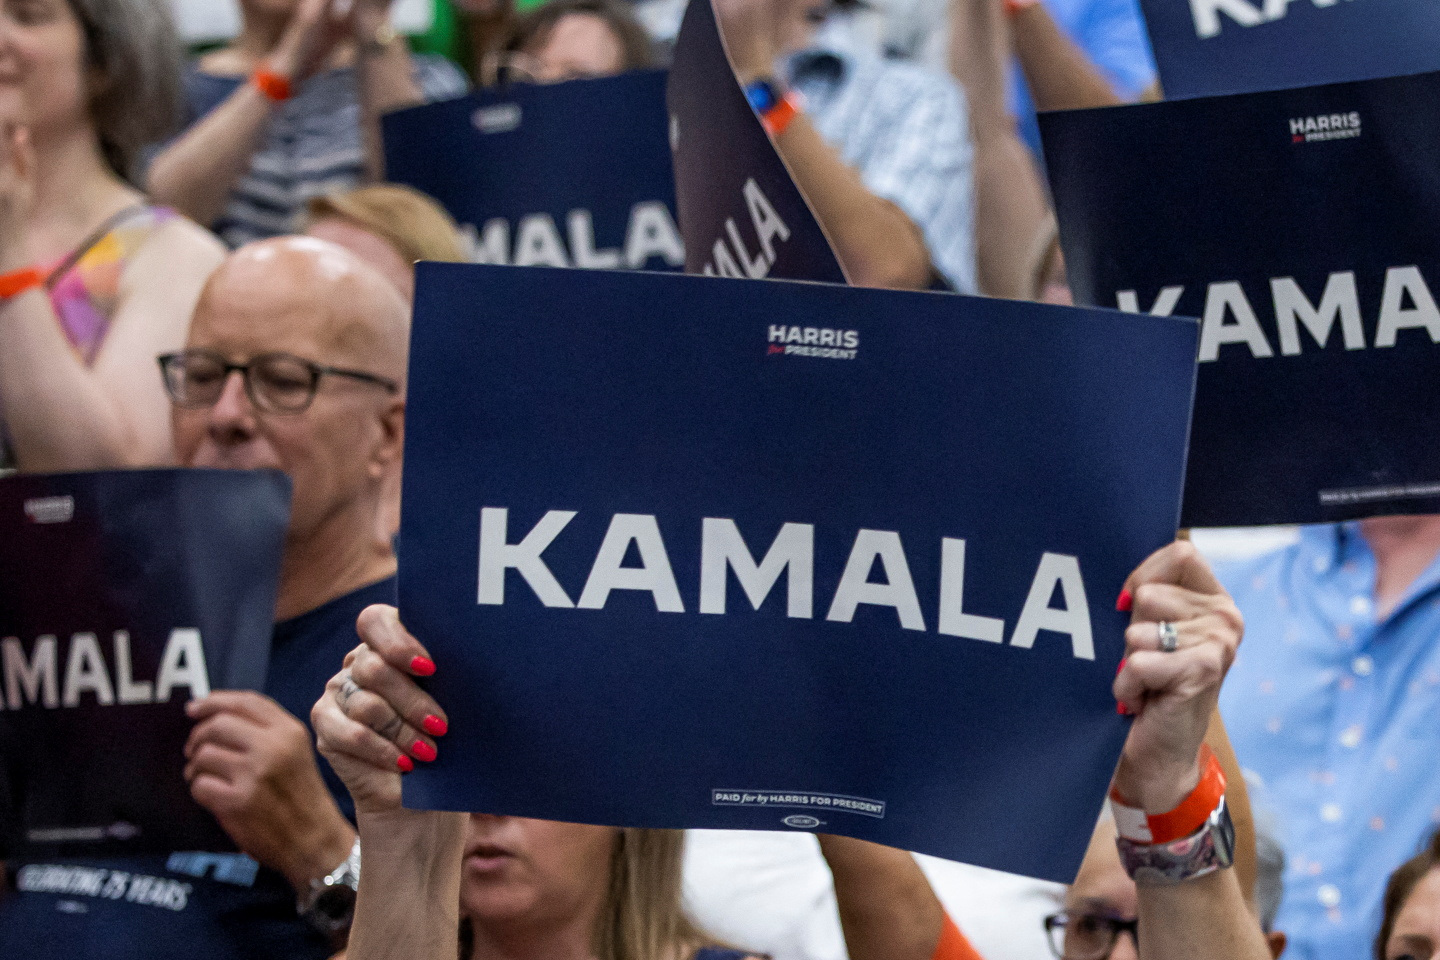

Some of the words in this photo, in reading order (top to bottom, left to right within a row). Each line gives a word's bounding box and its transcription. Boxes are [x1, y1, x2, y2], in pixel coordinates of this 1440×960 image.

[1289, 111, 1361, 134] HARRIS
[458, 201, 687, 270] MALA
[704, 178, 791, 279] ALA
[767, 324, 859, 348] HARRIS
[785, 345, 858, 360] PRESIDENT
[477, 506, 1096, 661] KAMALA
[0, 626, 211, 711] MALA
[715, 793, 740, 801] PAID
[740, 793, 757, 804] for
[757, 794, 769, 805] by
[770, 795, 809, 804] HARRIS
[810, 796, 831, 806] FOR
[832, 798, 882, 813] PRESIDENT
